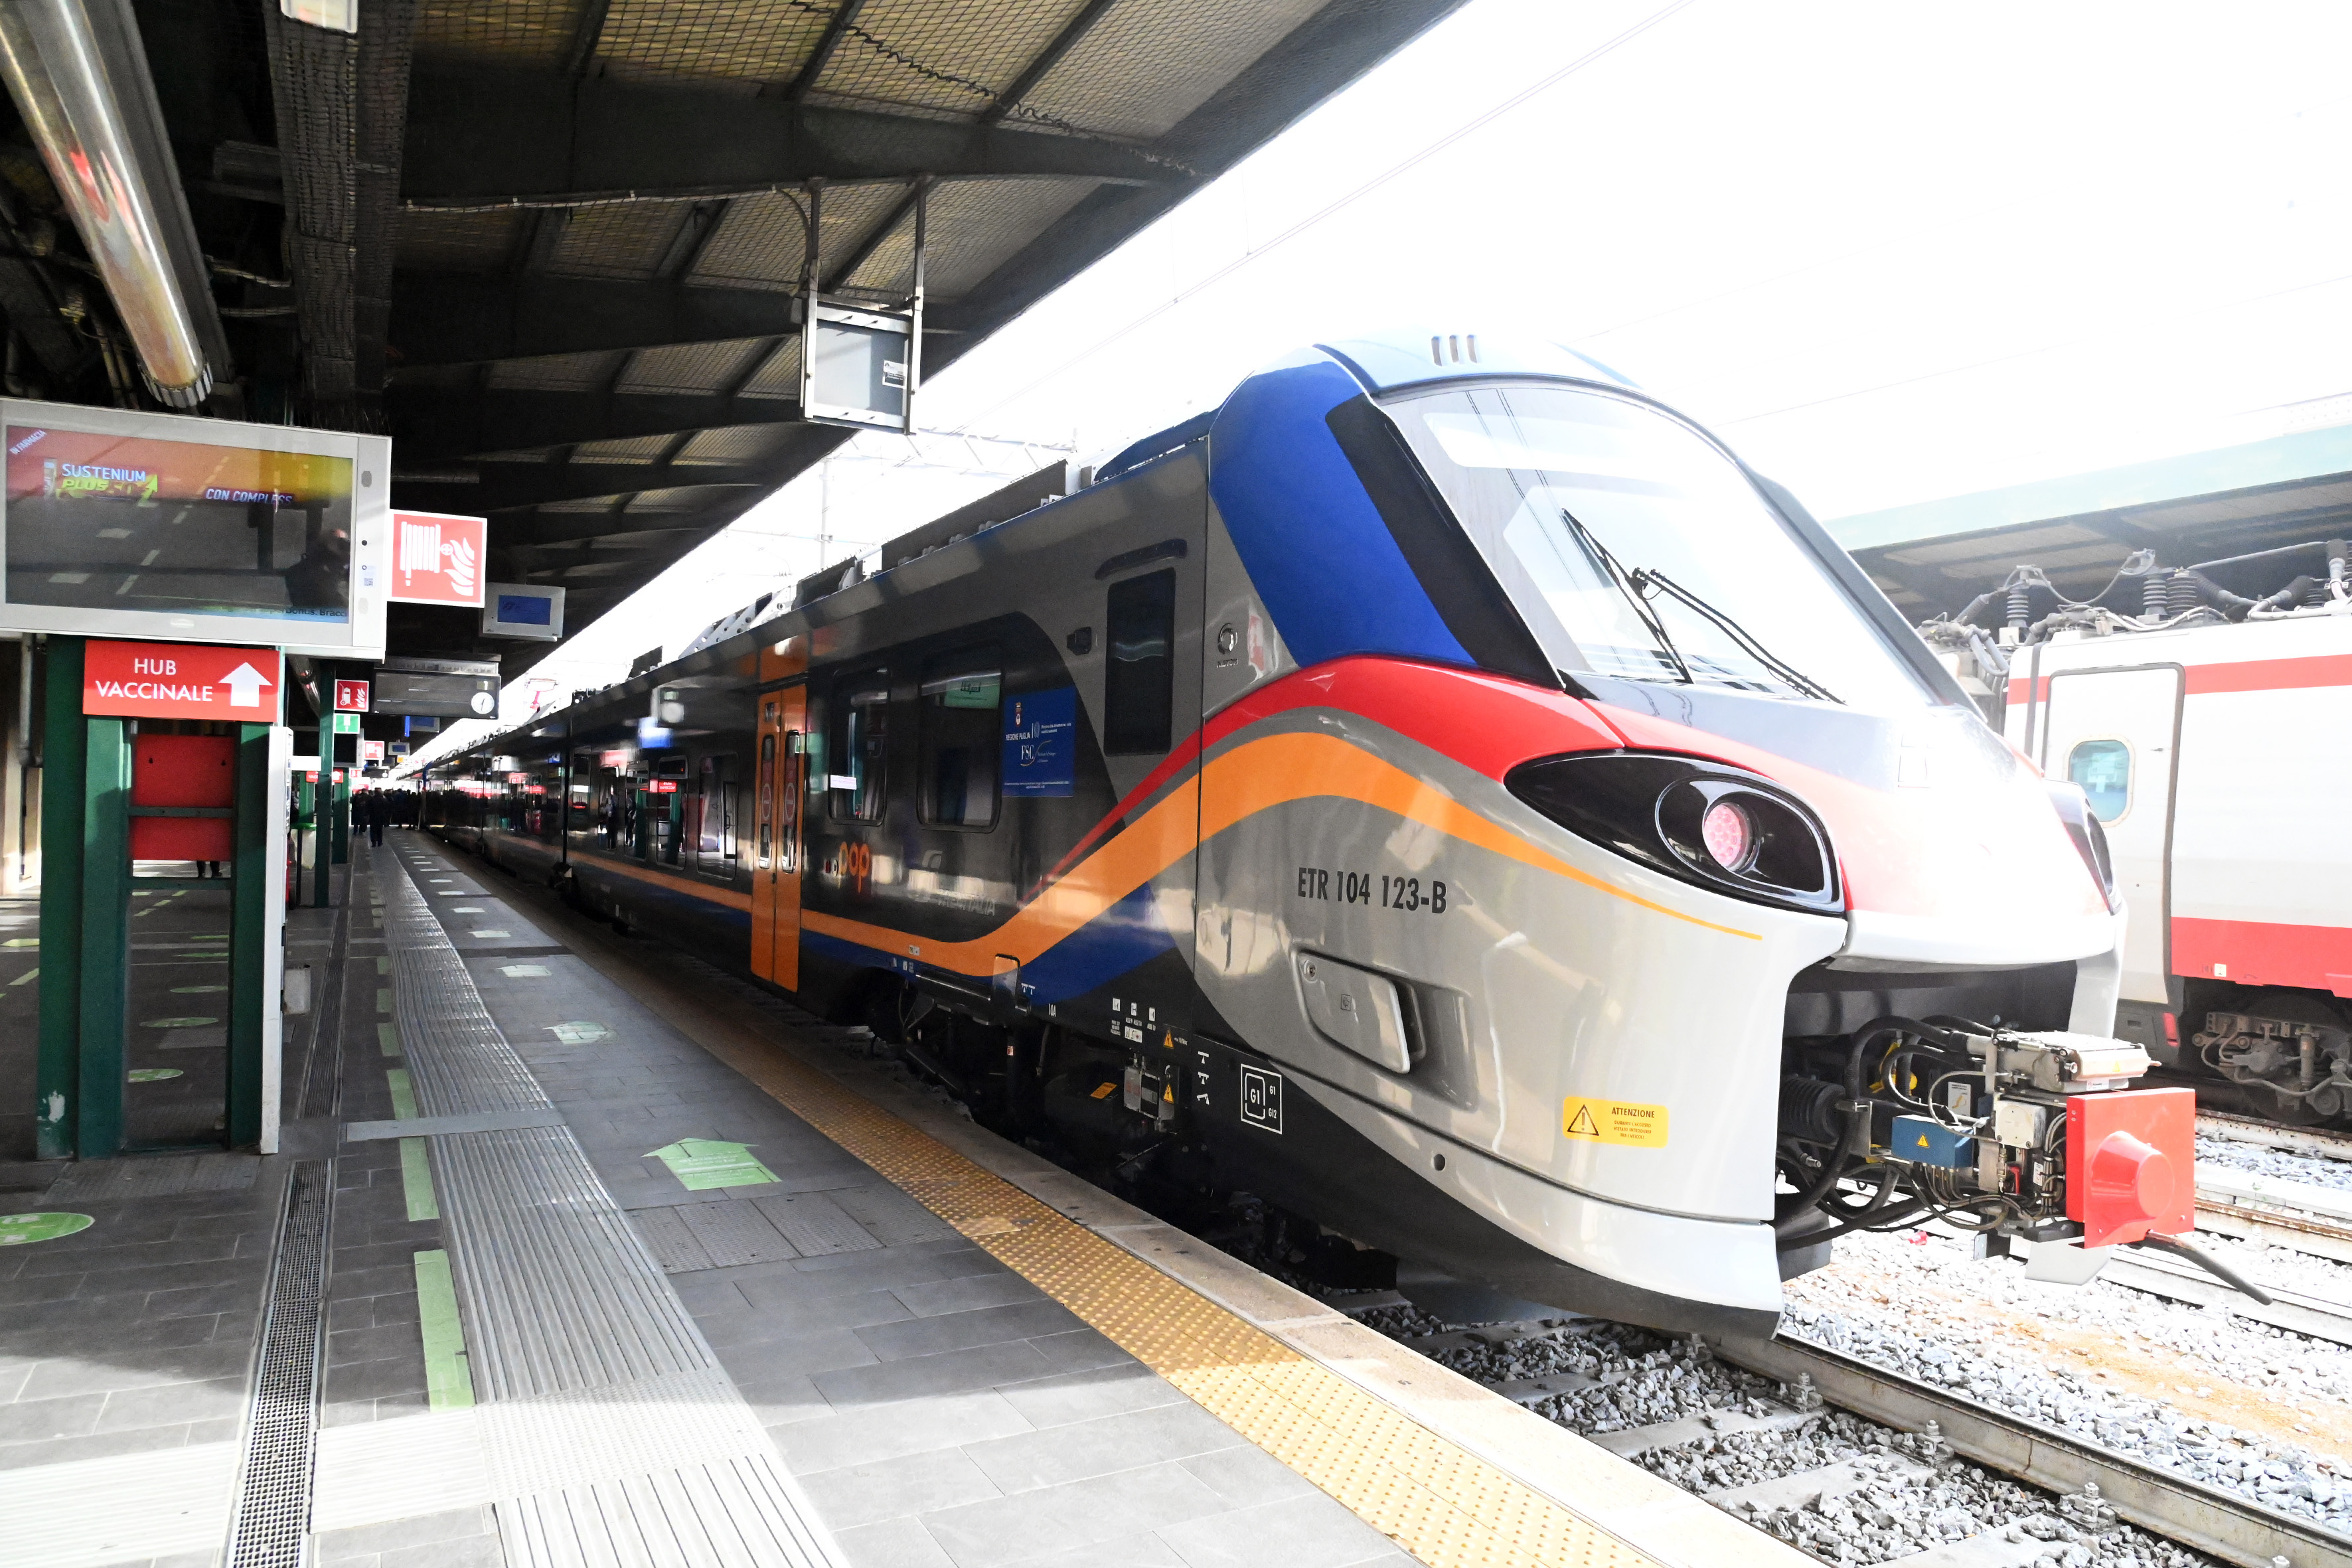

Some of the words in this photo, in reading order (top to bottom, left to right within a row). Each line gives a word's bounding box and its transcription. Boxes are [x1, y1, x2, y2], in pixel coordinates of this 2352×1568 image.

[17, 430, 46, 451] FARMACIA
[62, 463, 146, 482] SUSTENIUM
[62, 478, 110, 491] PLUS
[205, 488, 230, 501] CON
[134, 658, 177, 676] HUB
[95, 680, 213, 702] VACCINALE
[1020, 745, 1034, 760] FSC
[838, 841, 870, 894] pop
[1298, 867, 1328, 900] ETR
[1337, 870, 1371, 905] 104
[1382, 875, 1447, 914] 123-B
[1250, 1088, 1260, 1105] G1
[1269, 1085, 1276, 1095] G1
[1611, 1107, 1655, 1118] ATTENZIONE
